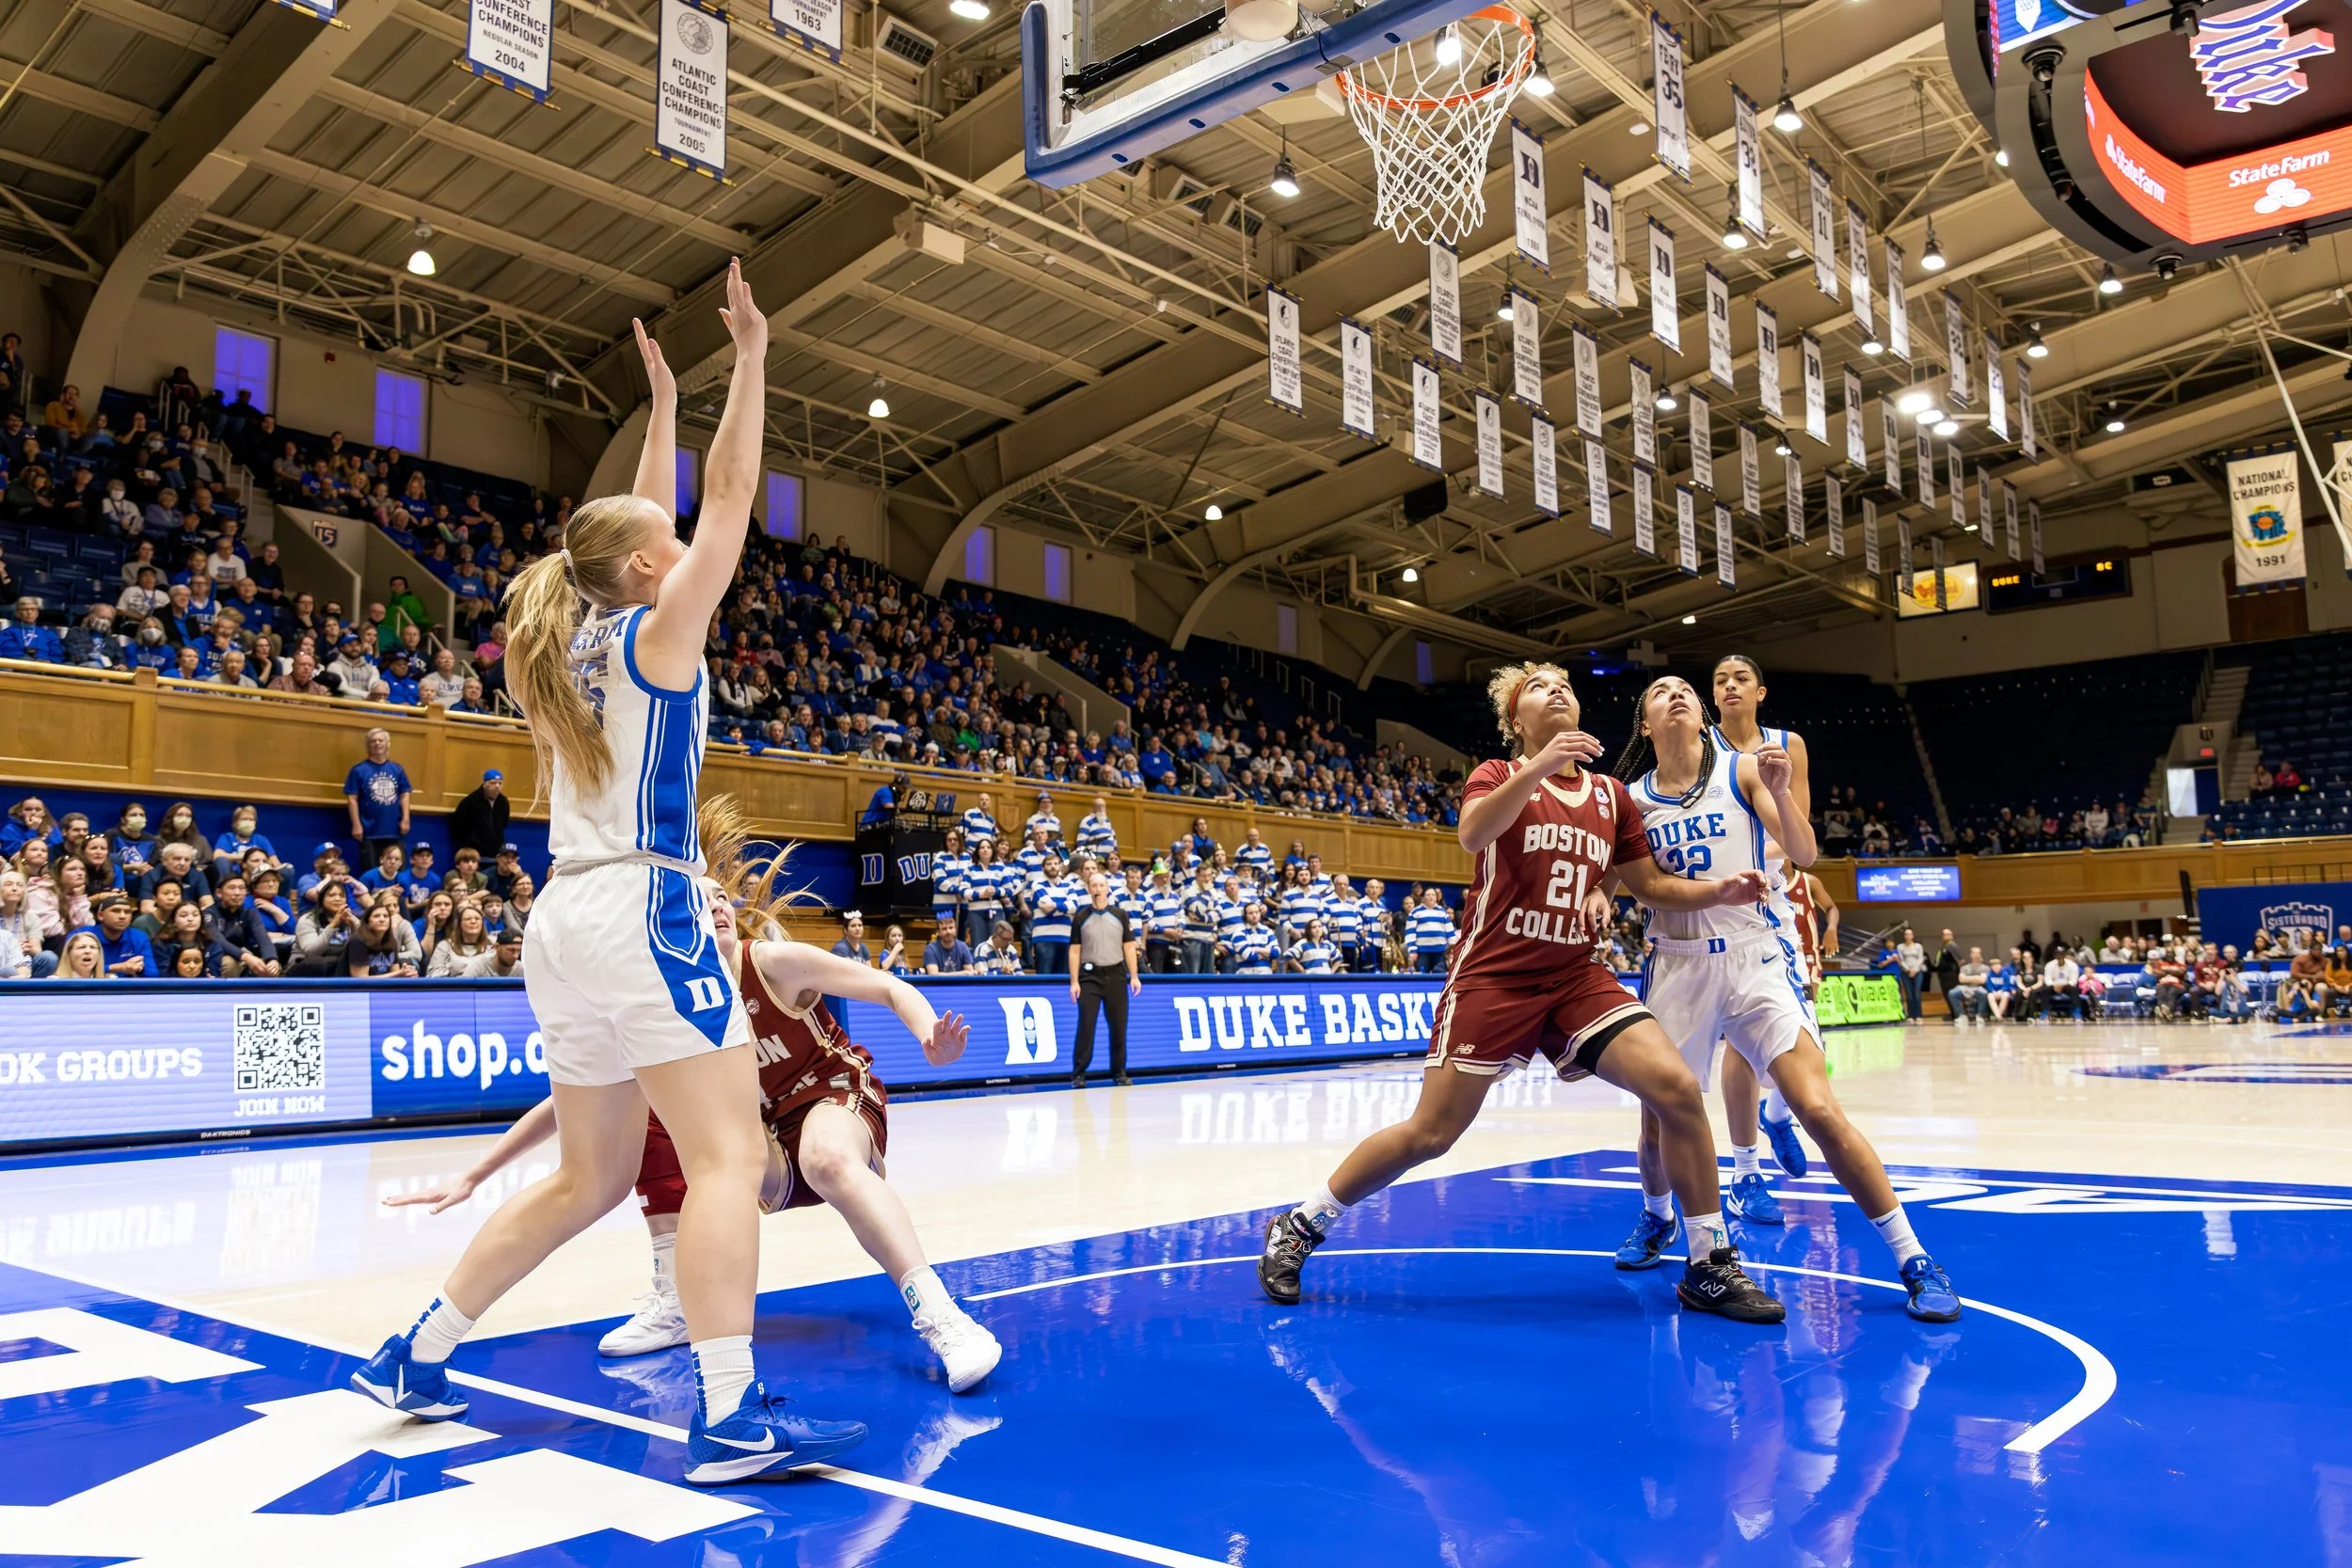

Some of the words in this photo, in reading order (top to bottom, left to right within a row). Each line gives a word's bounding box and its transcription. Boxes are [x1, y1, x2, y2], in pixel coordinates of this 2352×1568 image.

[478, 9, 545, 48] CHAMPIONS
[795, 9, 821, 31] 1963
[483, 29, 514, 50] REGULAR
[515, 42, 539, 60] SEASON
[495, 49, 526, 73] 2004
[672, 57, 717, 87] ATLANTIC
[678, 74, 709, 96] COAST
[662, 81, 725, 118] CONFERENCE
[1661, 70, 1683, 110] 35
[664, 96, 722, 130] CHAMPIONS
[679, 133, 706, 153] 2005
[2114, 146, 2167, 204] StateFarm
[2228, 150, 2330, 188] StateFarm
[2233, 482, 2295, 501] CHAMPIONS
[2238, 469, 2289, 486] NATIONAL
[318, 528, 335, 545] 15
[1522, 823, 1611, 873] BOSTON
[1647, 813, 1726, 852] DUKE
[861, 853, 884, 886] D
[1546, 859, 1589, 911] 21
[1708, 938, 1726, 954] D
[683, 977, 726, 1014] D
[997, 996, 1058, 1065] D
[1173, 995, 1312, 1052] DUKE
[56, 1047, 203, 1082] GROUPS
[233, 1098, 279, 1117] JOIN
[283, 1095, 326, 1115] NOW
[200, 1129, 251, 1139] DAKTRONICS
